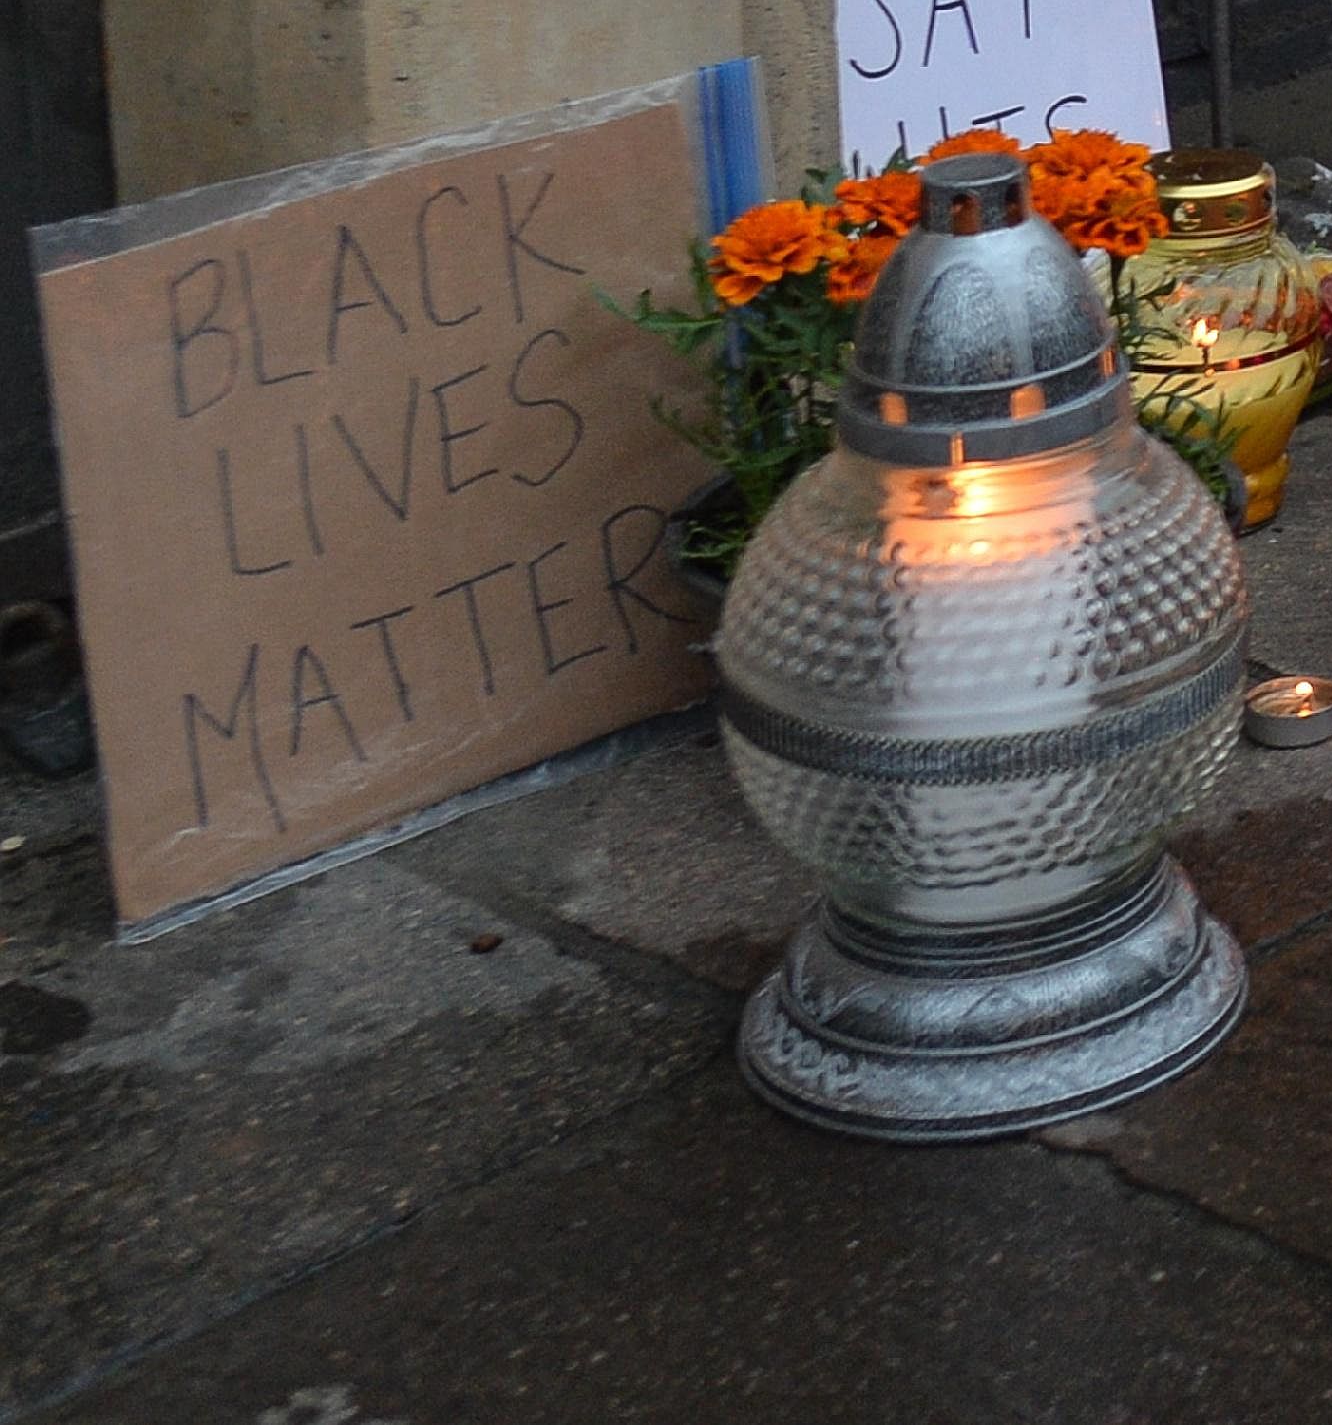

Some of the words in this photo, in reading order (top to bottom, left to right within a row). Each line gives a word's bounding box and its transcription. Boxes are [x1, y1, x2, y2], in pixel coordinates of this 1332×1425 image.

[168, 172, 588, 419] BLACK
[216, 328, 586, 577] LIVES
[181, 503, 700, 835] MATTER
